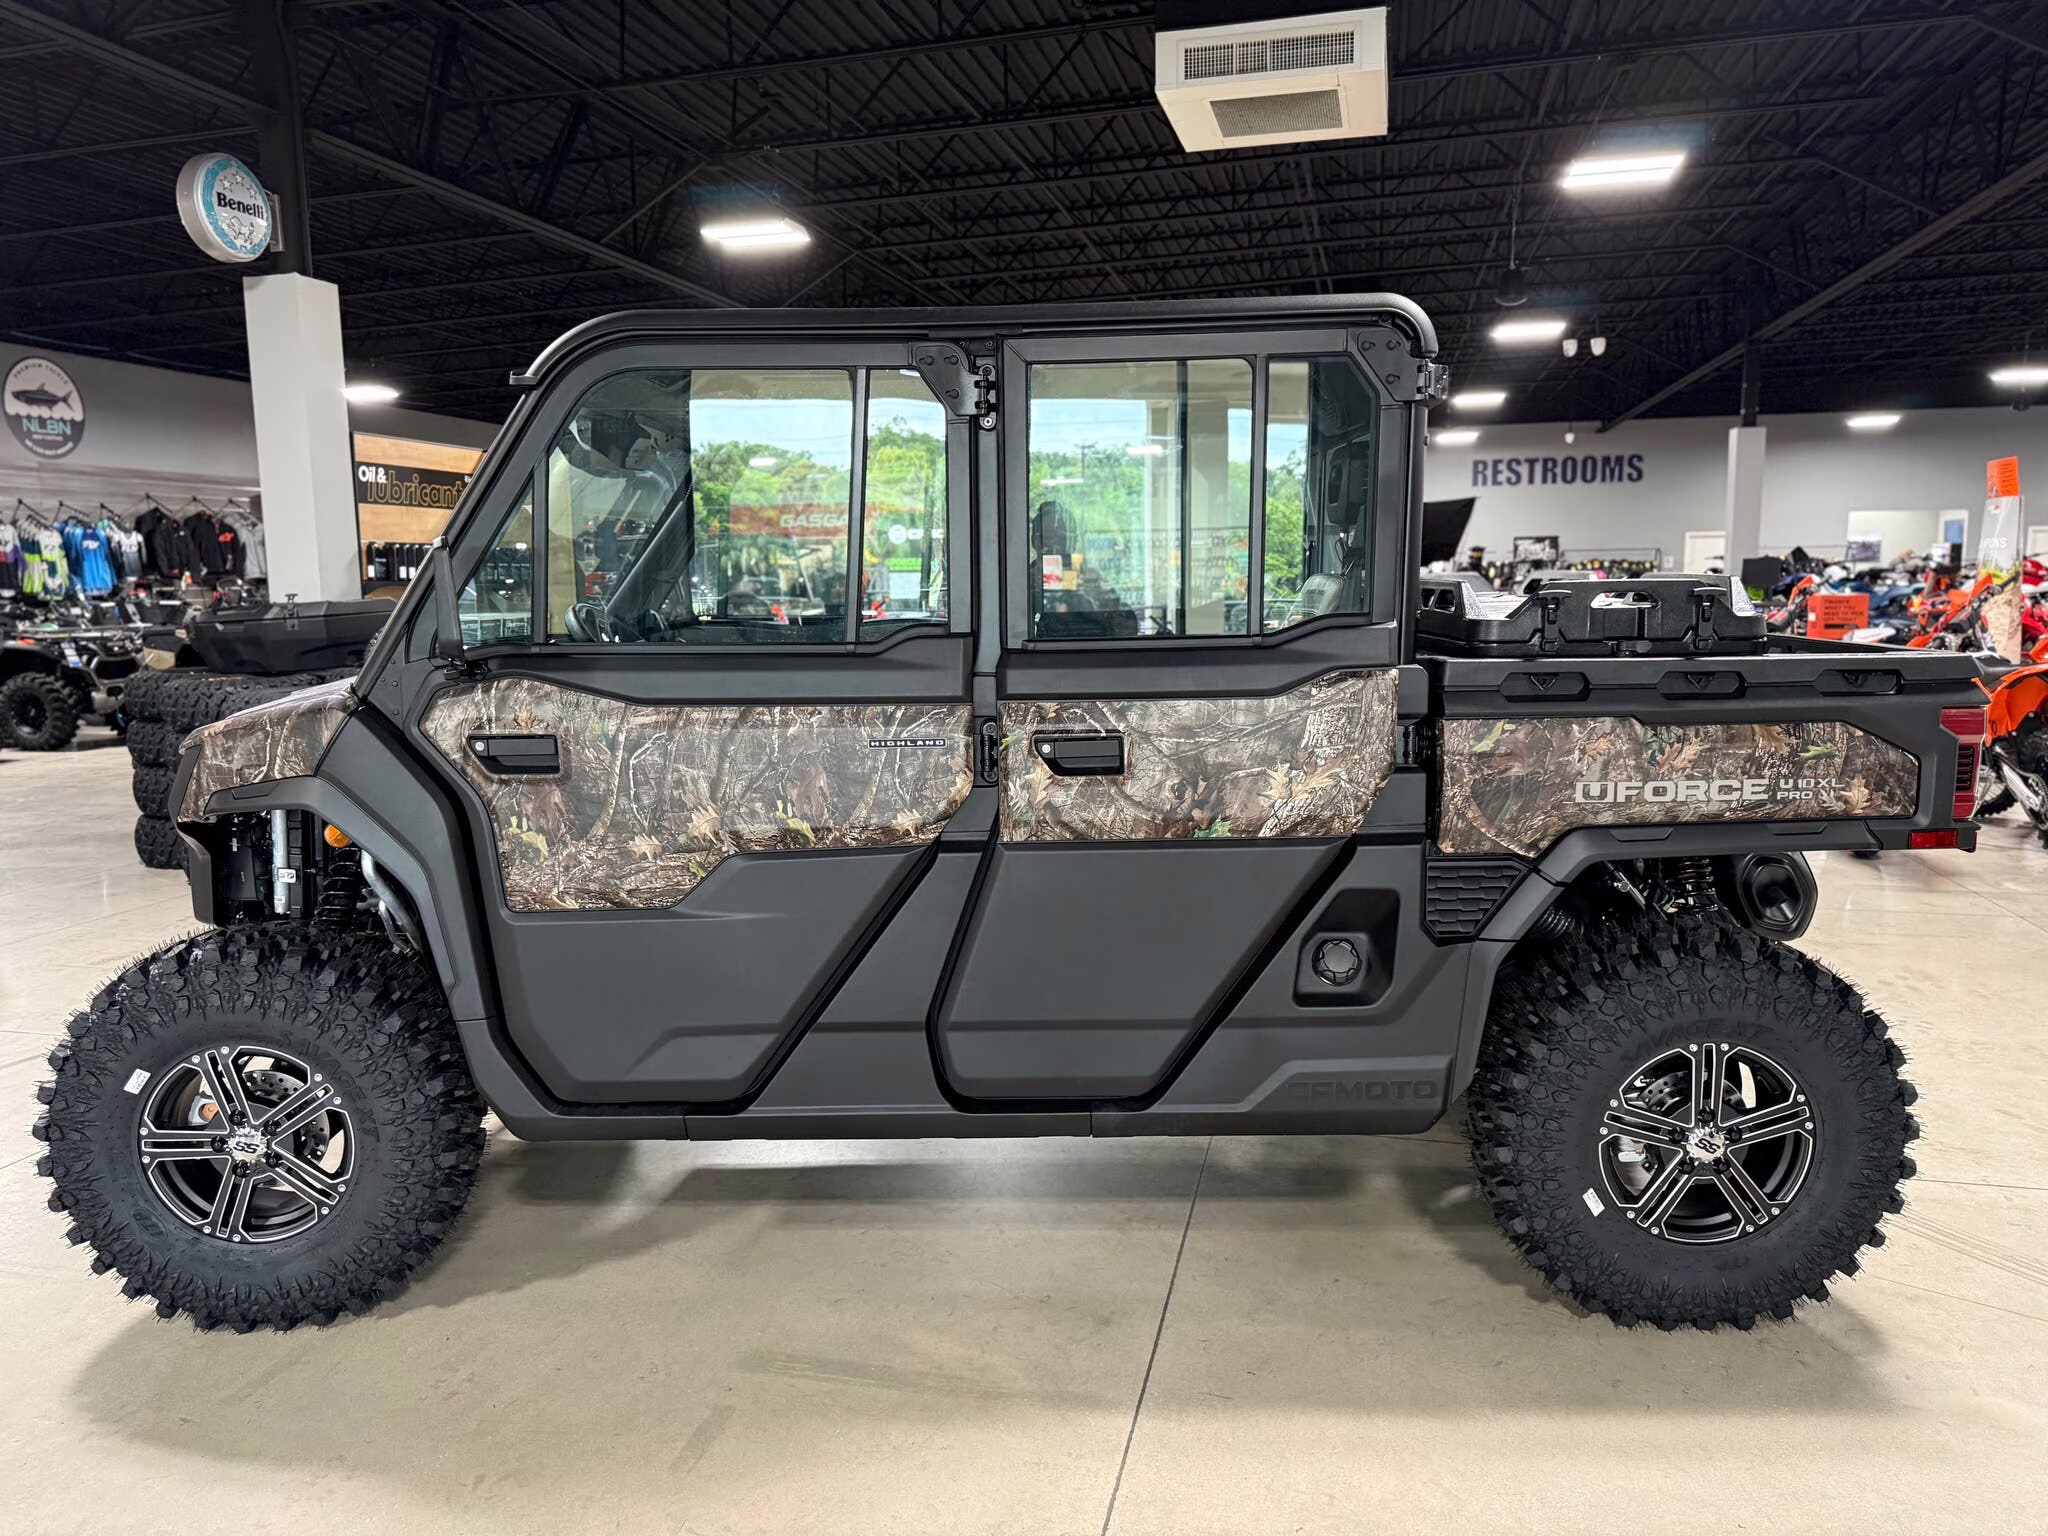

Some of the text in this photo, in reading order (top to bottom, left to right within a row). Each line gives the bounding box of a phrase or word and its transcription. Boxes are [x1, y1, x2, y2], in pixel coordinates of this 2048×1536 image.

[216, 191, 265, 220] Benelli
[22, 418, 72, 436] NLBN
[358, 465, 388, 484] Oil &
[1471, 453, 1645, 488] RESTROOMS
[367, 470, 463, 507] lubricant
[780, 513, 849, 528] GASGA
[870, 739, 945, 748] HIGHLAND
[1576, 778, 1770, 803] UFORCE
[1776, 790, 1814, 800] PRO
[232, 1140, 261, 1155] SS
